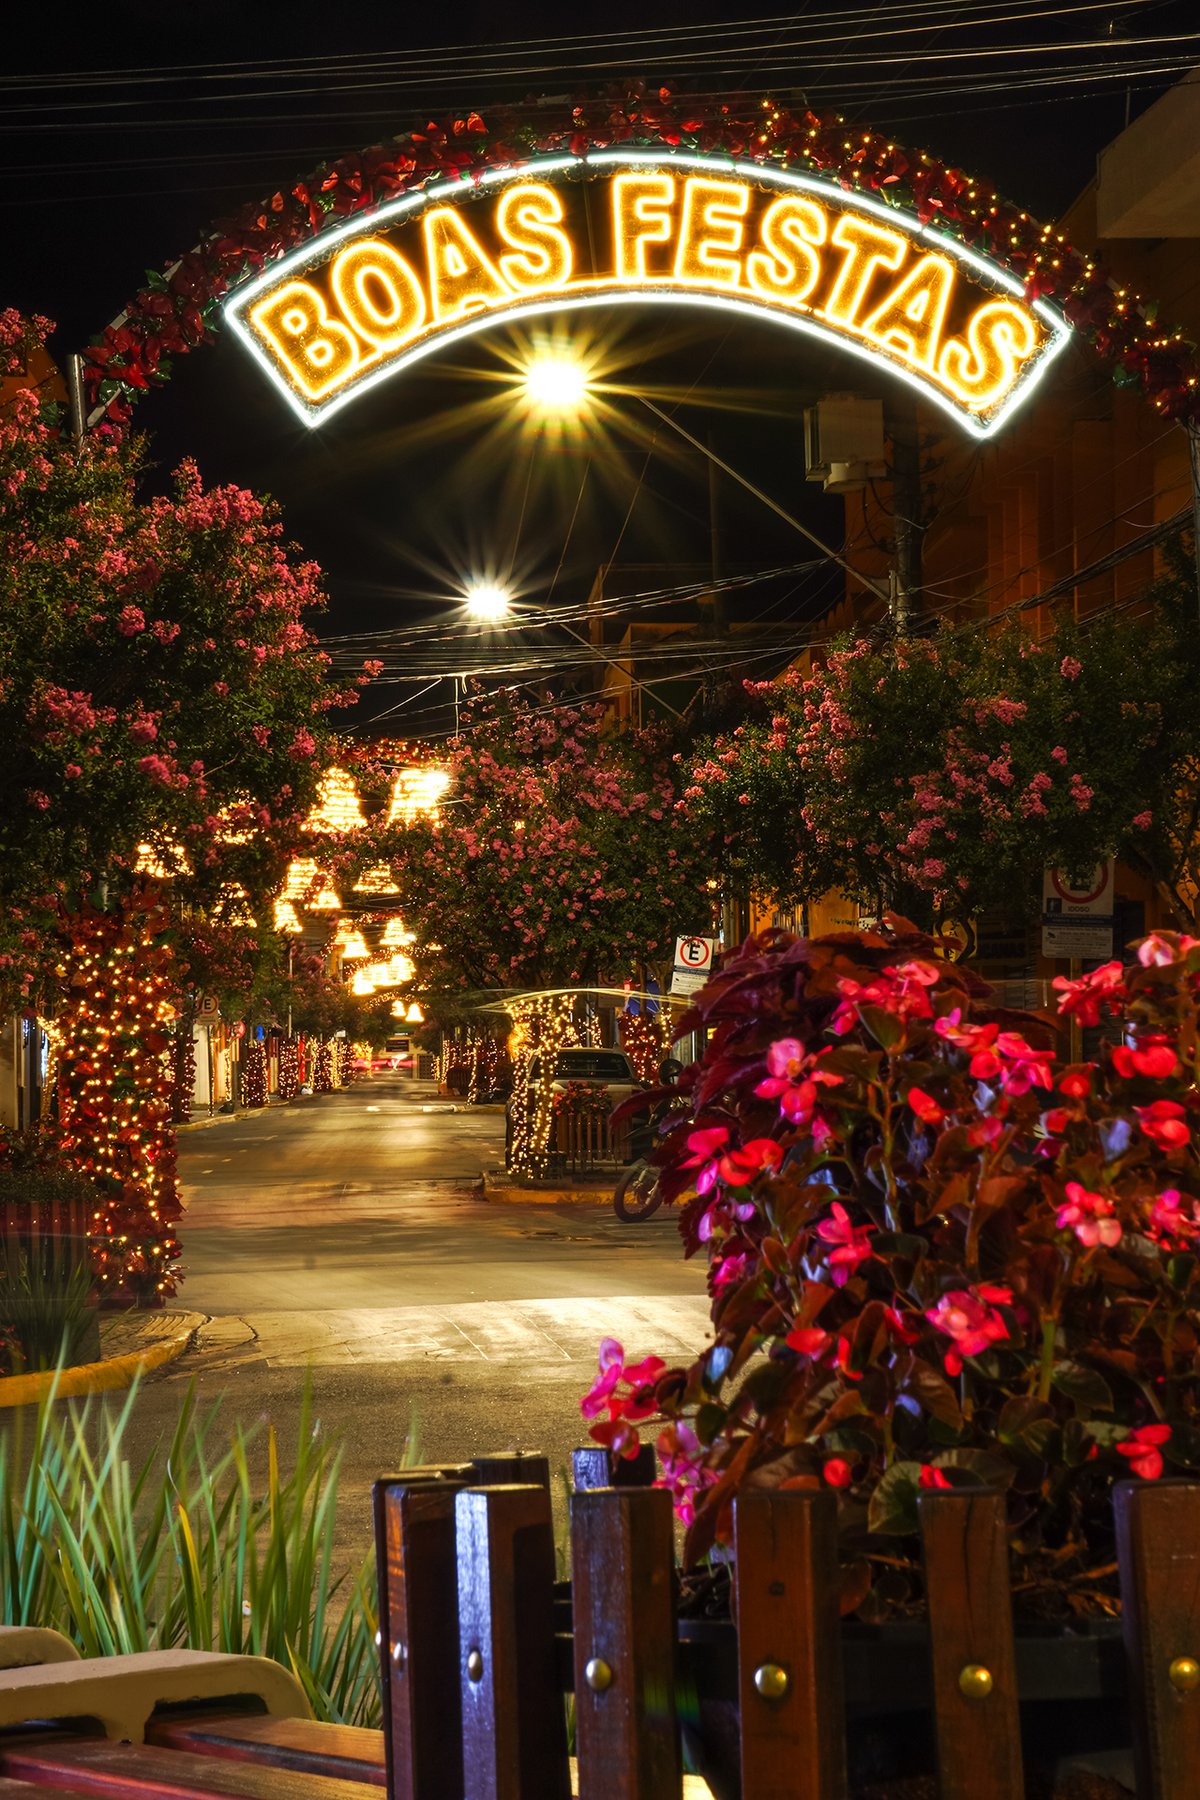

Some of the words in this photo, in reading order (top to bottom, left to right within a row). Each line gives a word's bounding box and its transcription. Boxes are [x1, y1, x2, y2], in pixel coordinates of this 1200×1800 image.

[250, 184, 573, 401] BOAS
[611, 174, 1036, 402] FESTAS
[689, 943, 700, 961] E
[204, 998, 211, 1010] E
